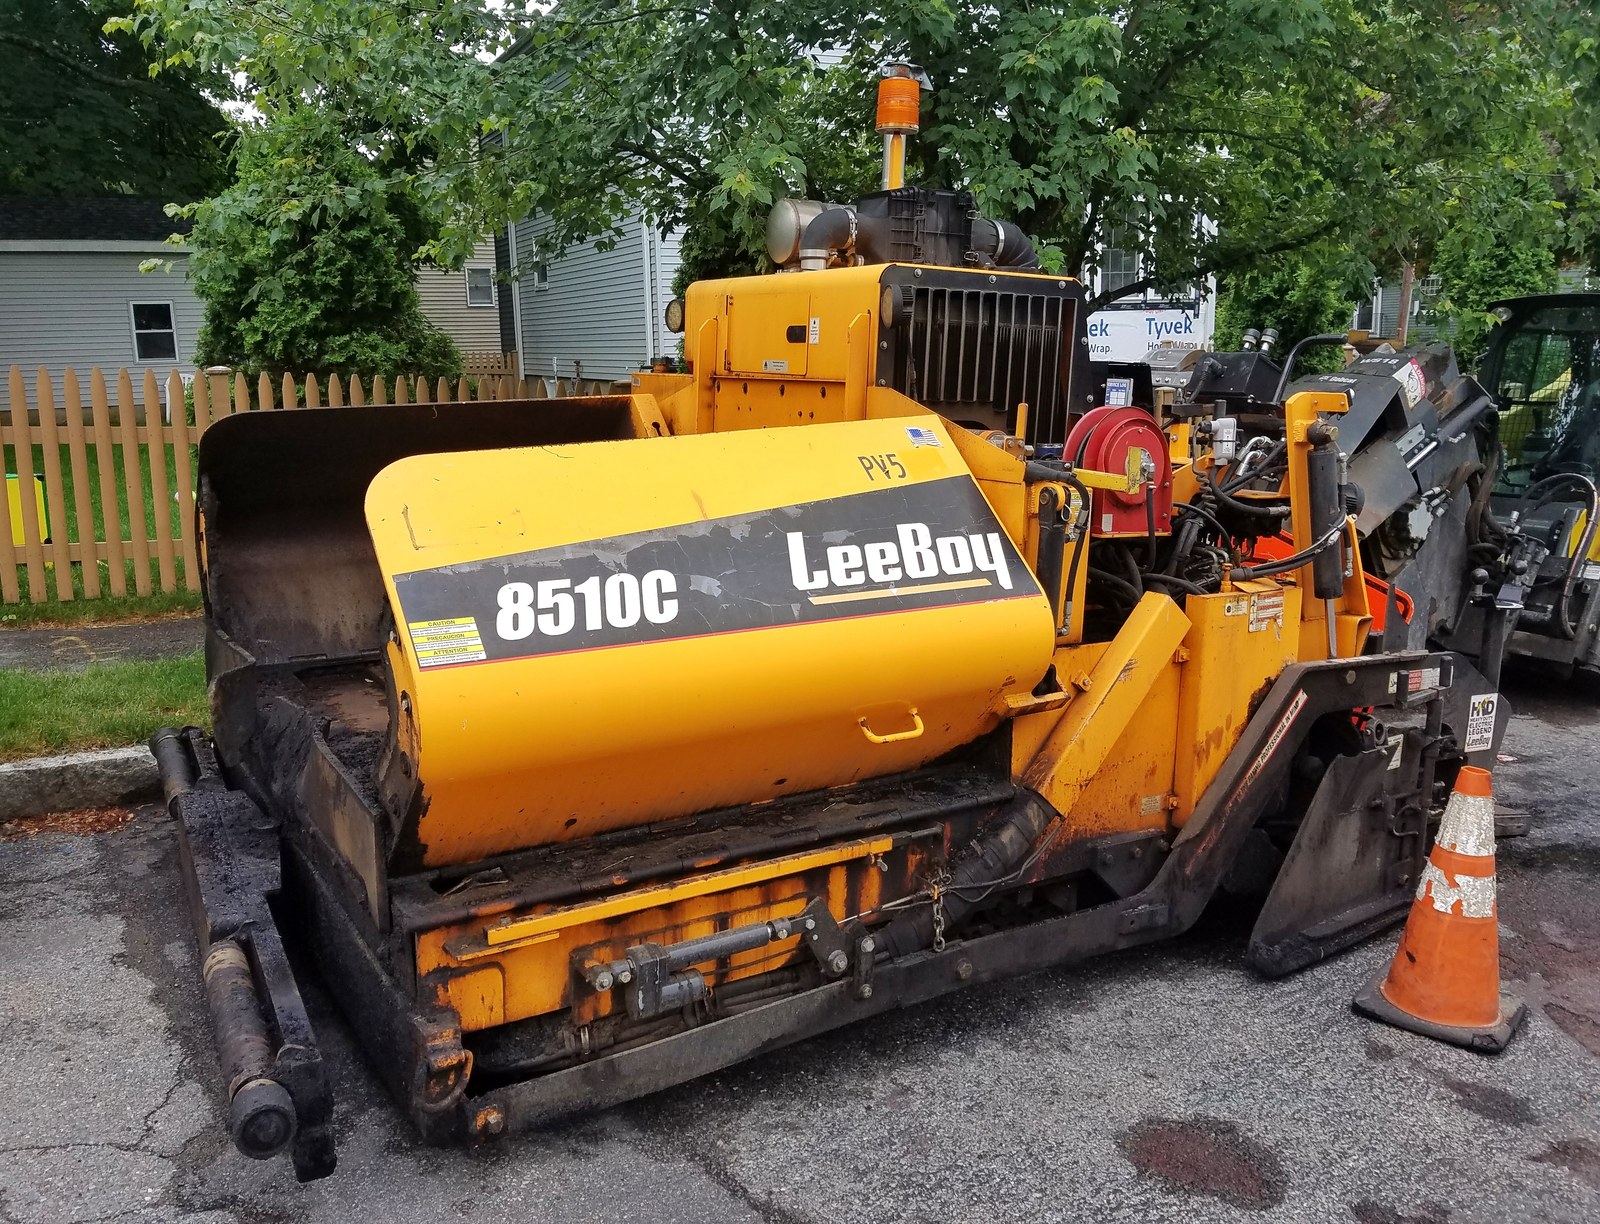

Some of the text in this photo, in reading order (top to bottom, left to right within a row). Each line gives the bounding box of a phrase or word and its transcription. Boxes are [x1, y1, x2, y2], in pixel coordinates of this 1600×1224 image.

[1145, 317, 1192, 340] Tyvek
[786, 522, 1013, 590] LeeBoy
[496, 569, 679, 641] 8510C
[427, 619, 456, 627] CAUTION
[433, 647, 468, 656] ATTENTION
[1469, 721, 1493, 729] ELECTRIC
[1468, 727, 1492, 736] LEGEND
[1467, 735, 1491, 747] LeeBoy
